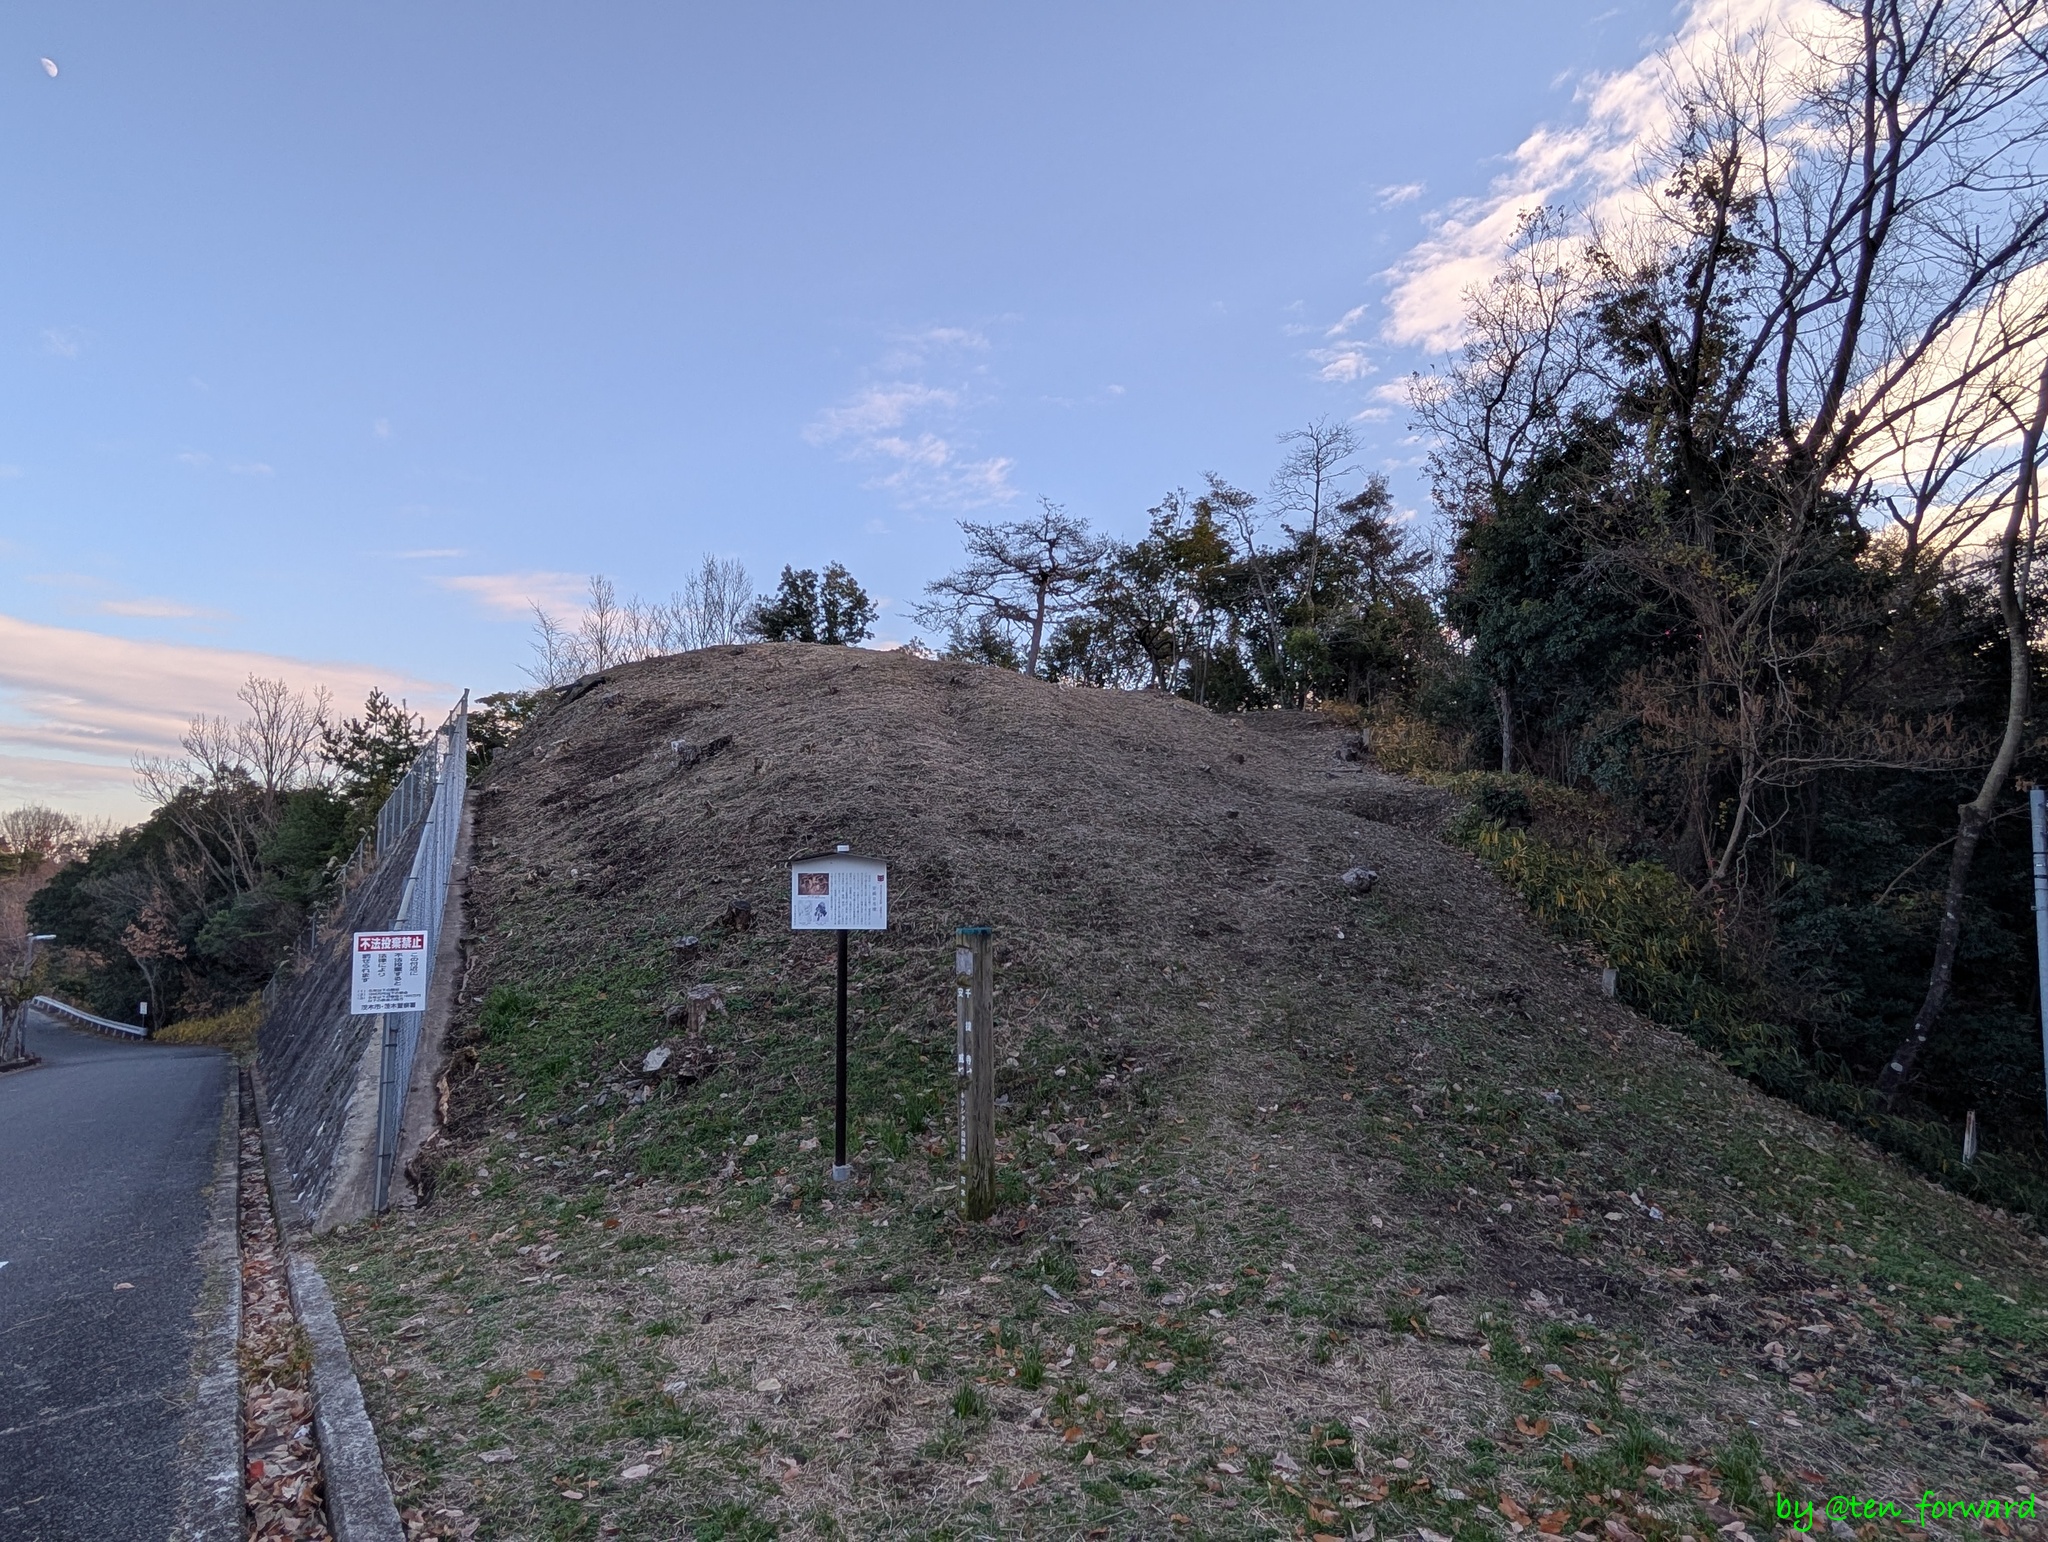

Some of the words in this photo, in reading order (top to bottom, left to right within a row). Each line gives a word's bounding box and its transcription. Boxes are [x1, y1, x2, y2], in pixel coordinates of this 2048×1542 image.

[360, 936, 421, 950] 不法投棄禁止
